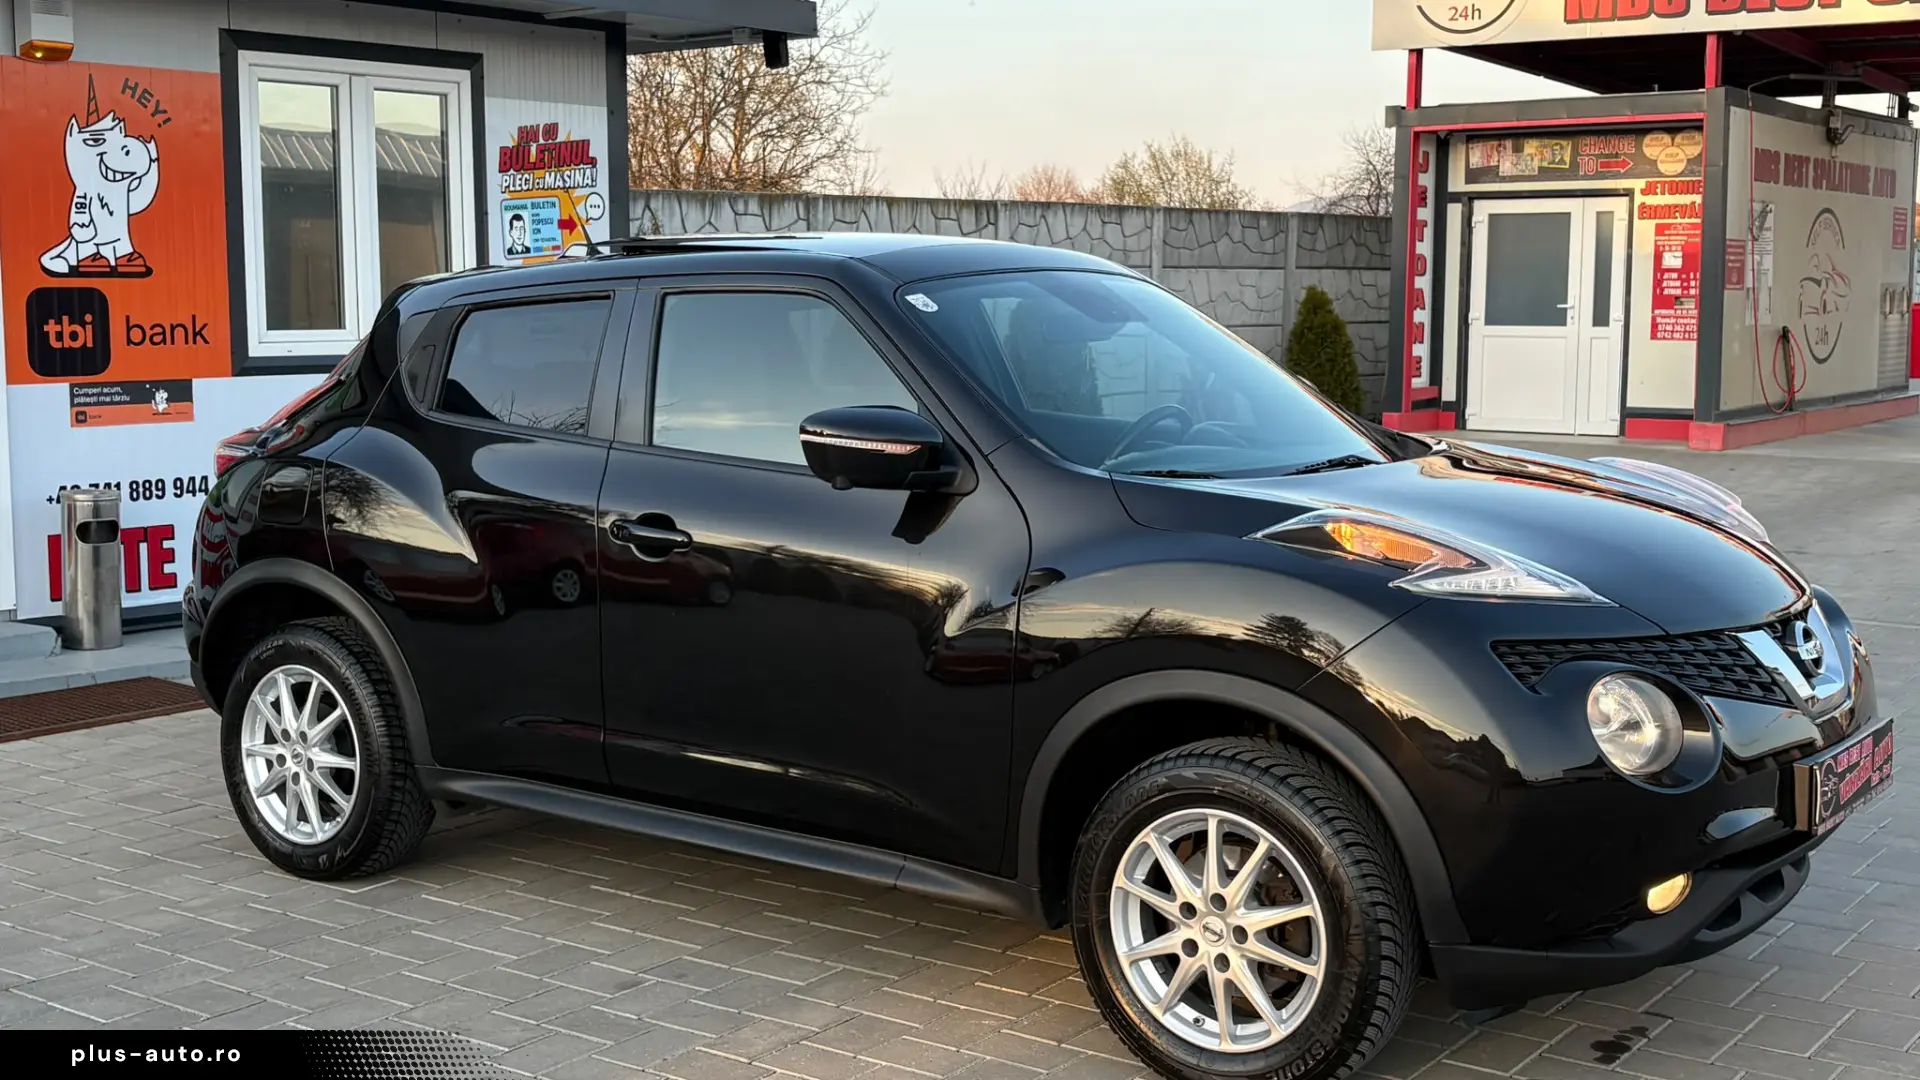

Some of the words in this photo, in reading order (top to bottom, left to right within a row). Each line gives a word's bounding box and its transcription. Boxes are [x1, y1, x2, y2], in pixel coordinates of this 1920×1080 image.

[1448, 3, 1481, 21] 24h
[120, 77, 172, 128] HEY!
[517, 124, 540, 144] HAI
[541, 122, 559, 142] CU
[1578, 135, 1636, 154] CHANGE
[1578, 157, 1597, 175] TO
[501, 172, 535, 193] PLECI
[74, 192, 87, 215] TBI
[531, 201, 556, 210] BULETIN
[43, 313, 93, 349] tbi
[125, 314, 210, 347] bank
[129, 478, 166, 502] 889
[172, 475, 210, 498] 944
